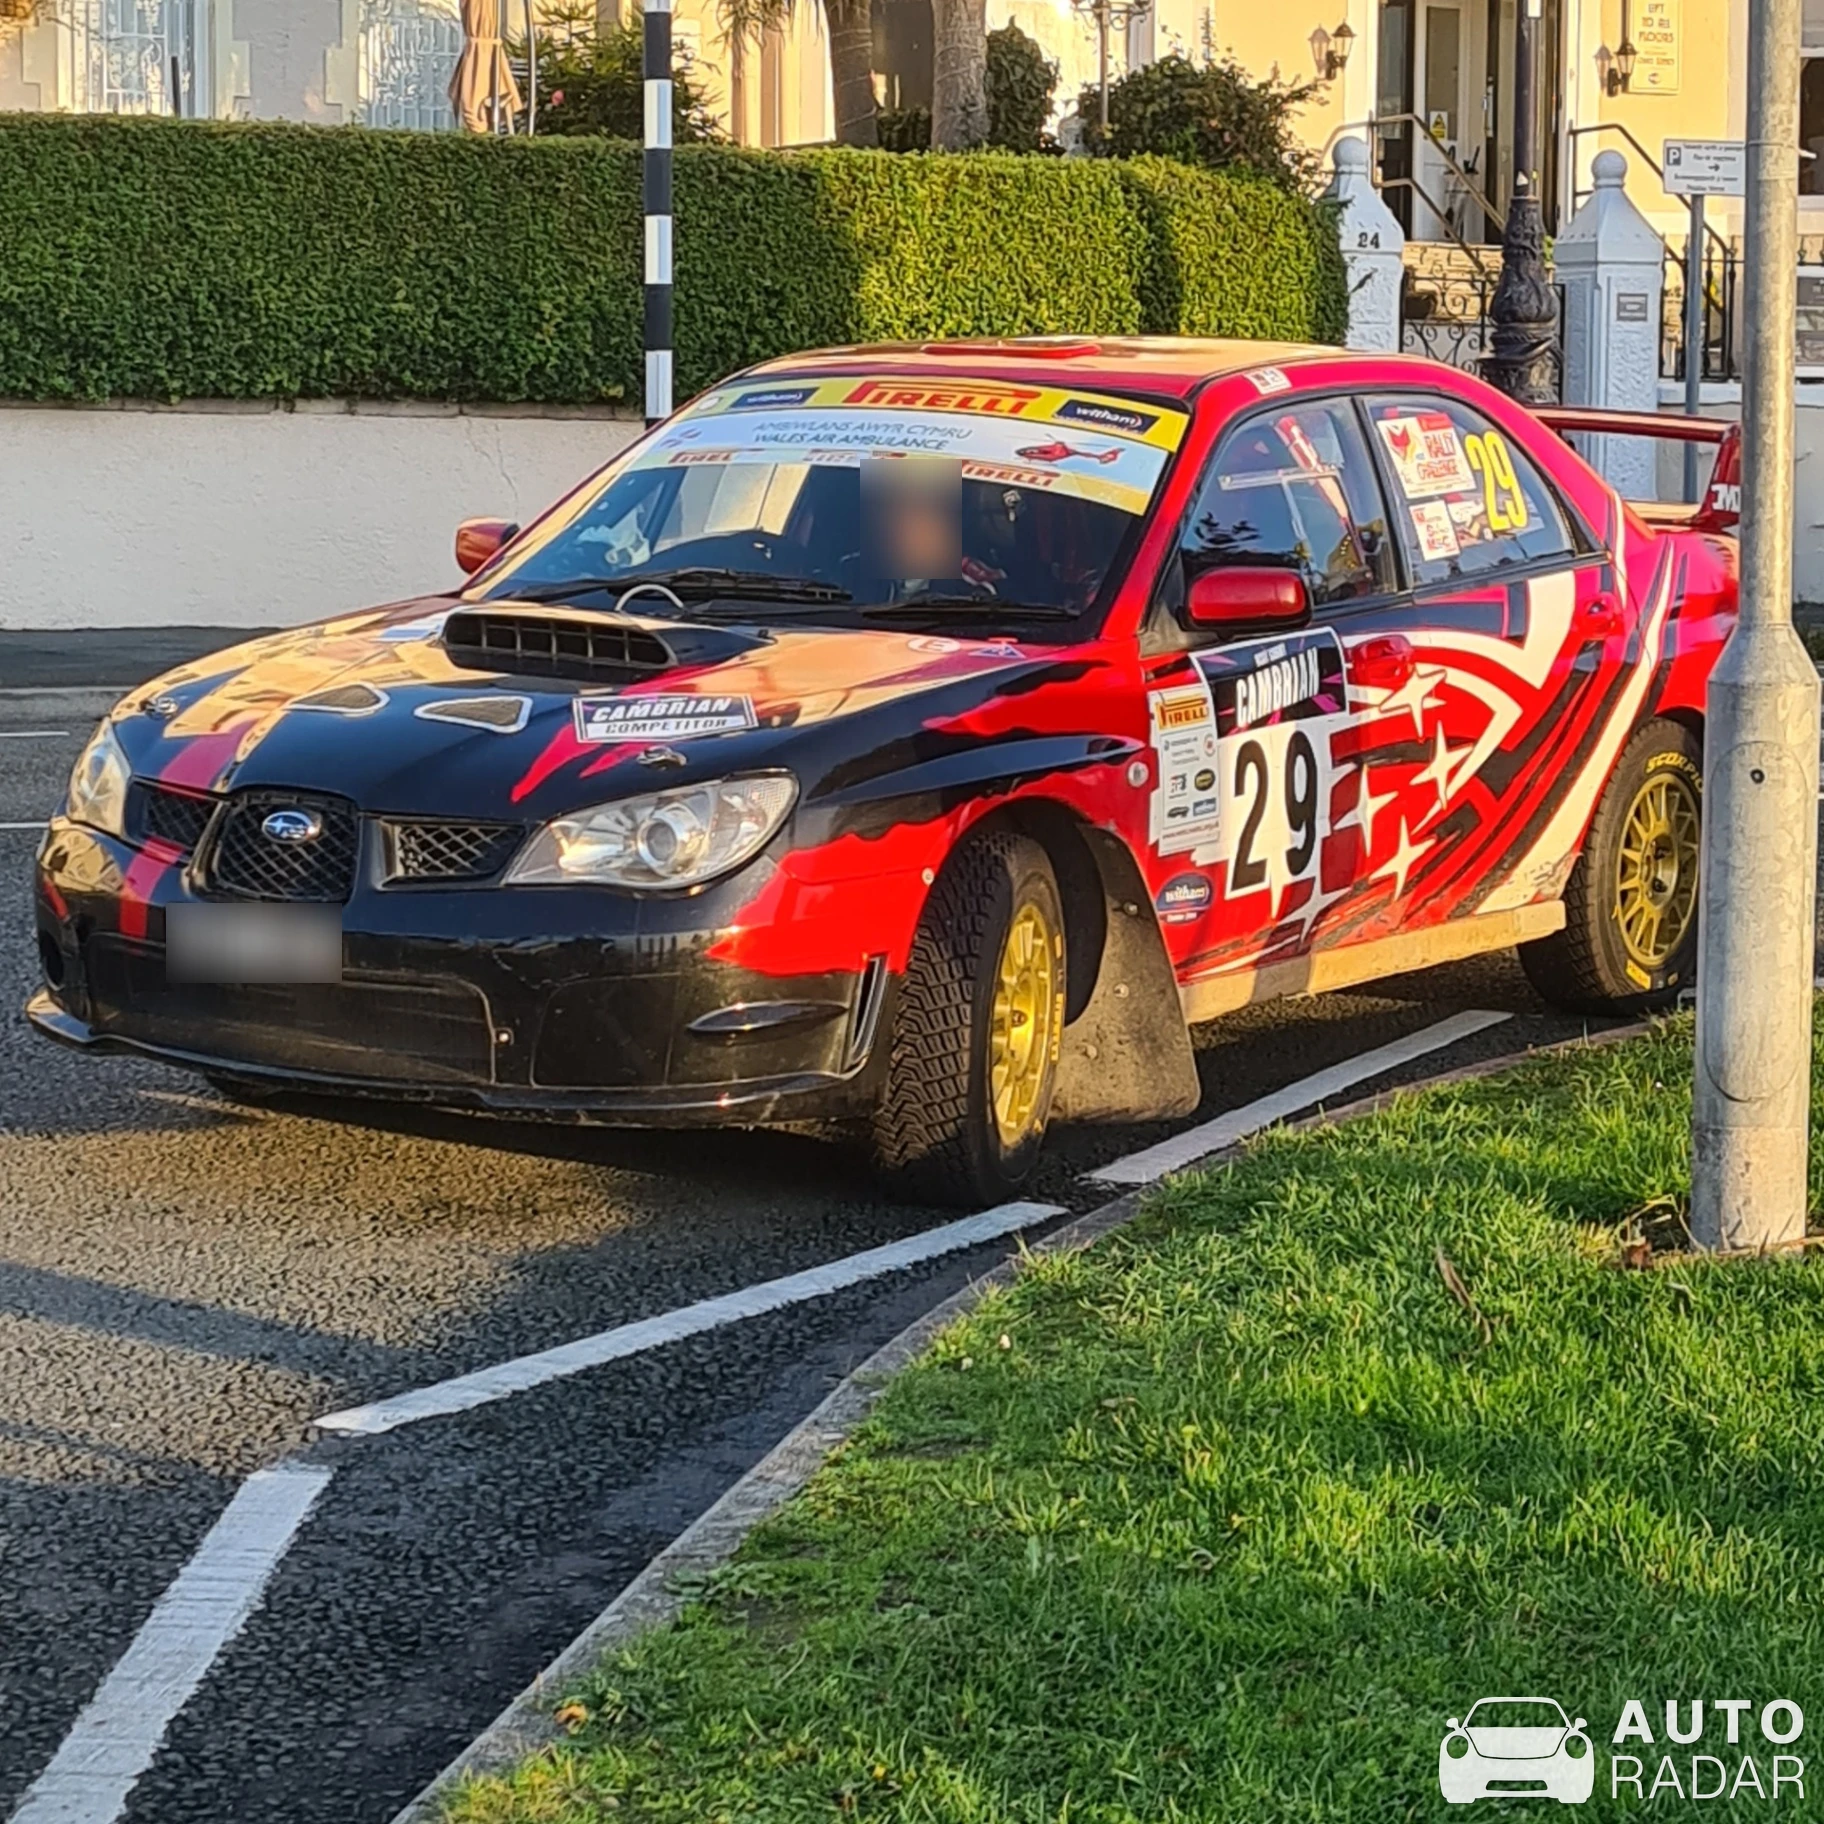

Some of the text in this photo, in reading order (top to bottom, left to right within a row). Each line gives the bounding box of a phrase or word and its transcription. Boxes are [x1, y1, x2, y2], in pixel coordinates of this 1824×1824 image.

[1668, 147, 1681, 166] P
[1357, 231, 1381, 250] 24
[842, 380, 1043, 415] PIRELLI
[1075, 405, 1137, 427] witham
[754, 432, 949, 451] WALES AIR AMBULANCE
[852, 420, 902, 434] AWYR
[906, 423, 974, 440] CYMRU
[962, 459, 1061, 487] IRELLI
[1464, 429, 1528, 532] 29
[1236, 646, 1320, 729] CAMBRIAN
[592, 697, 732, 722] CAMBRIAN
[605, 718, 728, 735] COMPETITOR
[1645, 752, 1704, 794] SCORPIO
[1230, 730, 1318, 892] 29
